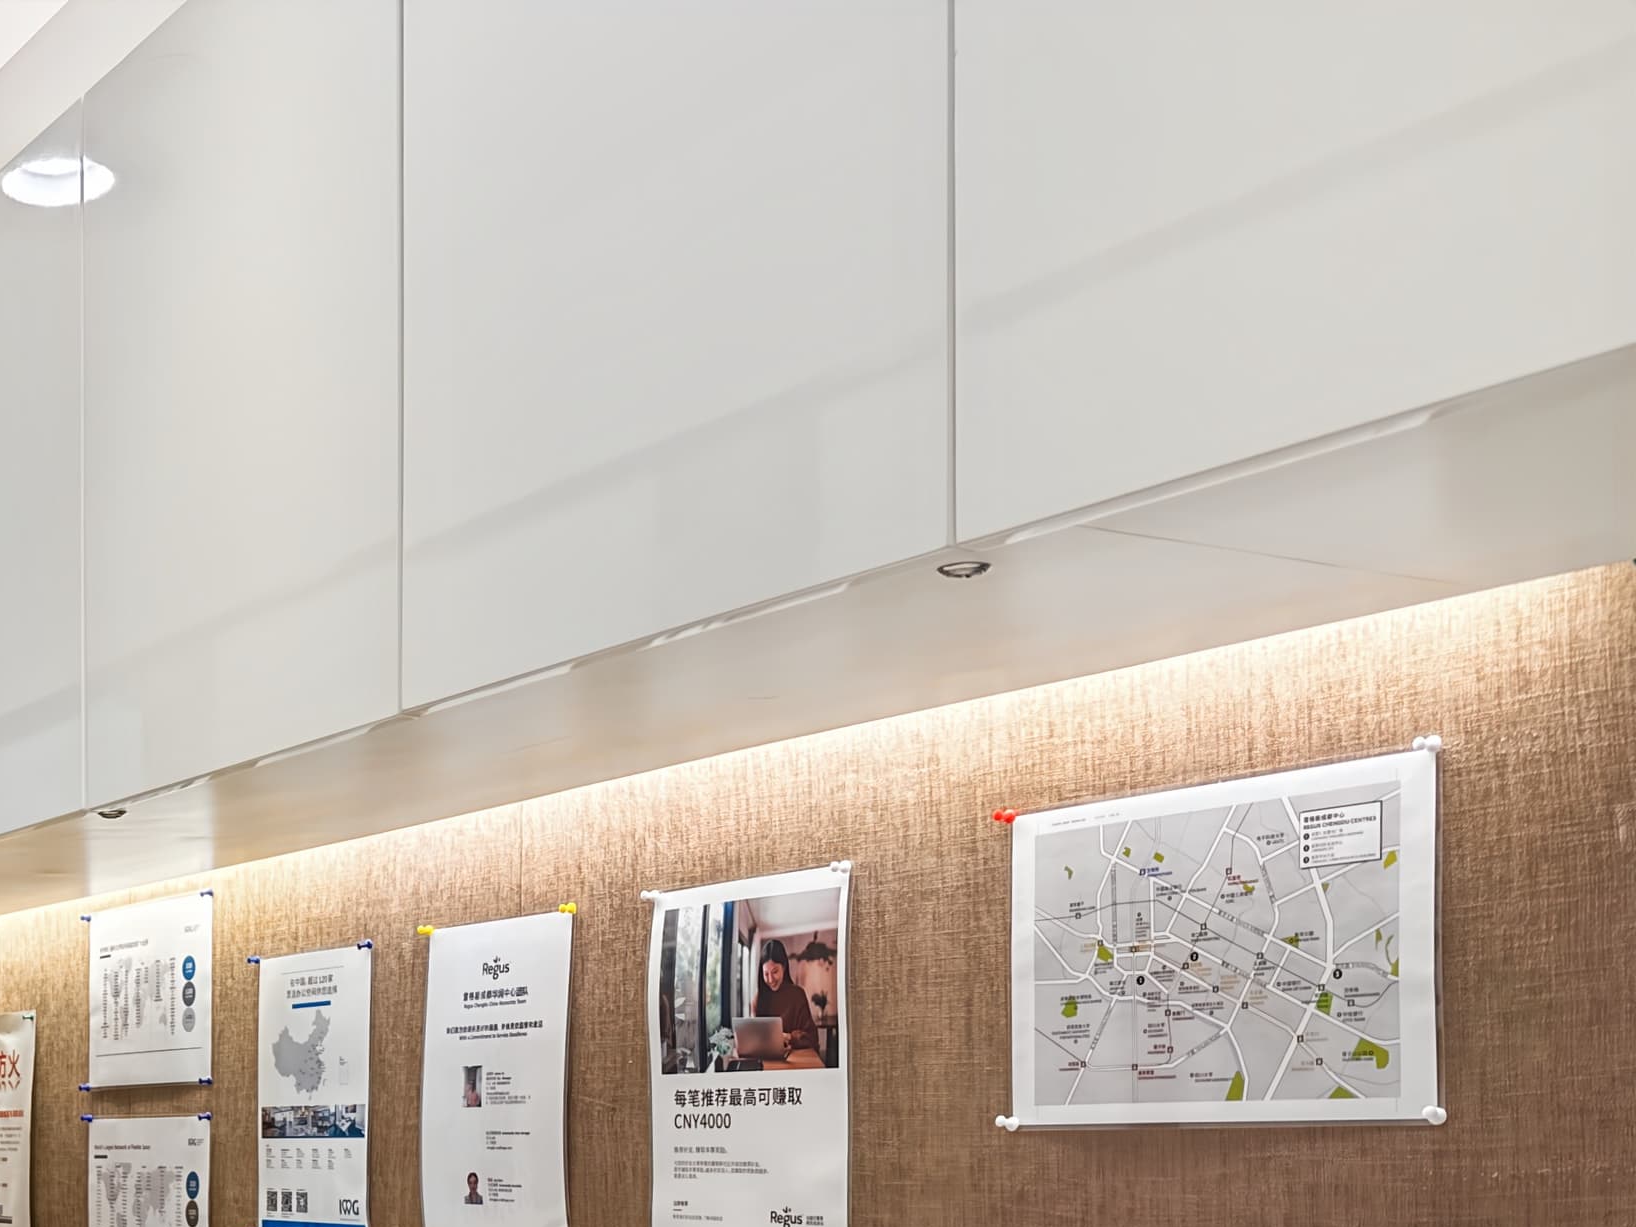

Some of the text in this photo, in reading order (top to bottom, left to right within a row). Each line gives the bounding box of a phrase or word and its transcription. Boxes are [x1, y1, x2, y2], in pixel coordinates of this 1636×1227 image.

[482, 961, 510, 980] Regus
[674, 1086, 803, 1108] 每笔推荐最高可赚取
[674, 1113, 732, 1129] CNY4000
[339, 1199, 359, 1216] IWG
